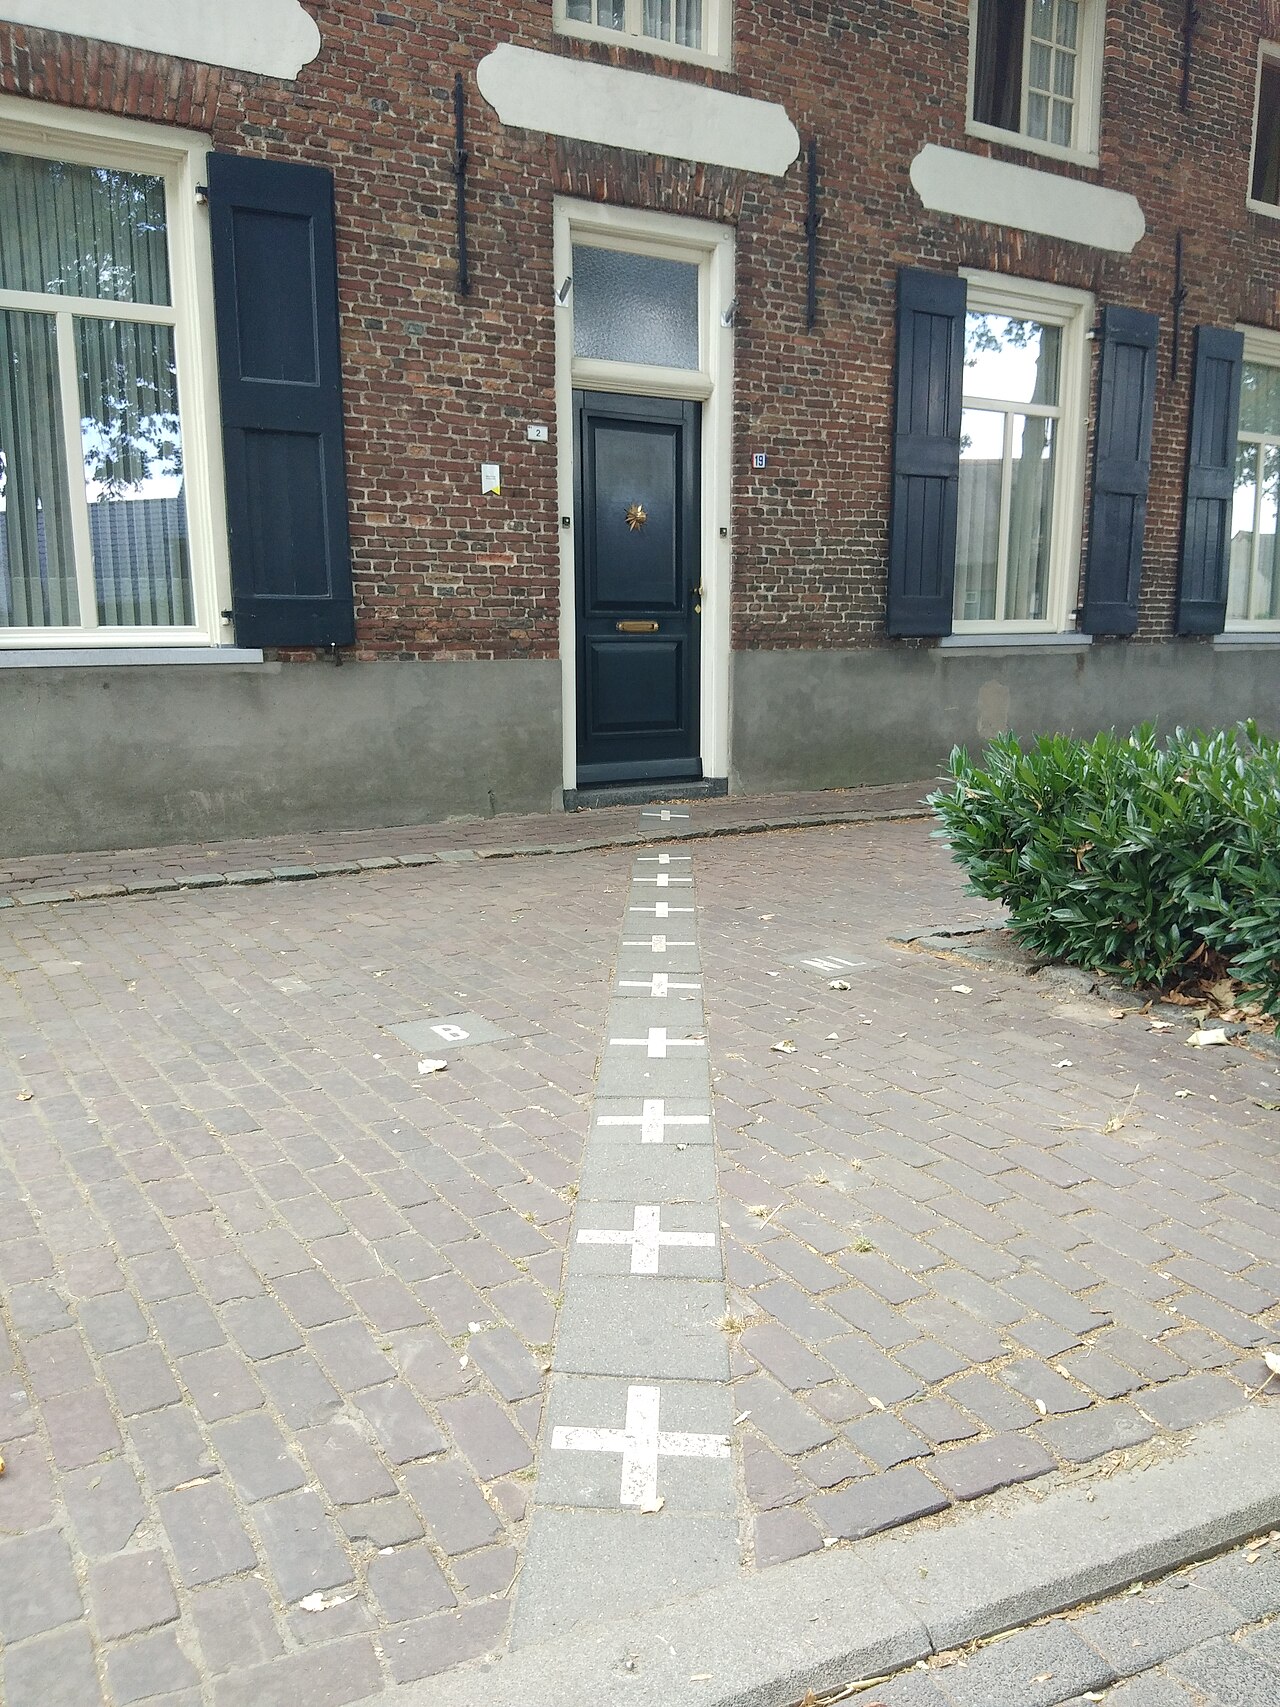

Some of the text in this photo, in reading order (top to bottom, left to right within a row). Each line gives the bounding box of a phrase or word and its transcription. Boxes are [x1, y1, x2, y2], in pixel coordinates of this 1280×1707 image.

[535, 429, 541, 437] 2
[755, 455, 764, 466] 19
[800, 955, 867, 971] NL
[430, 1024, 471, 1042] B
